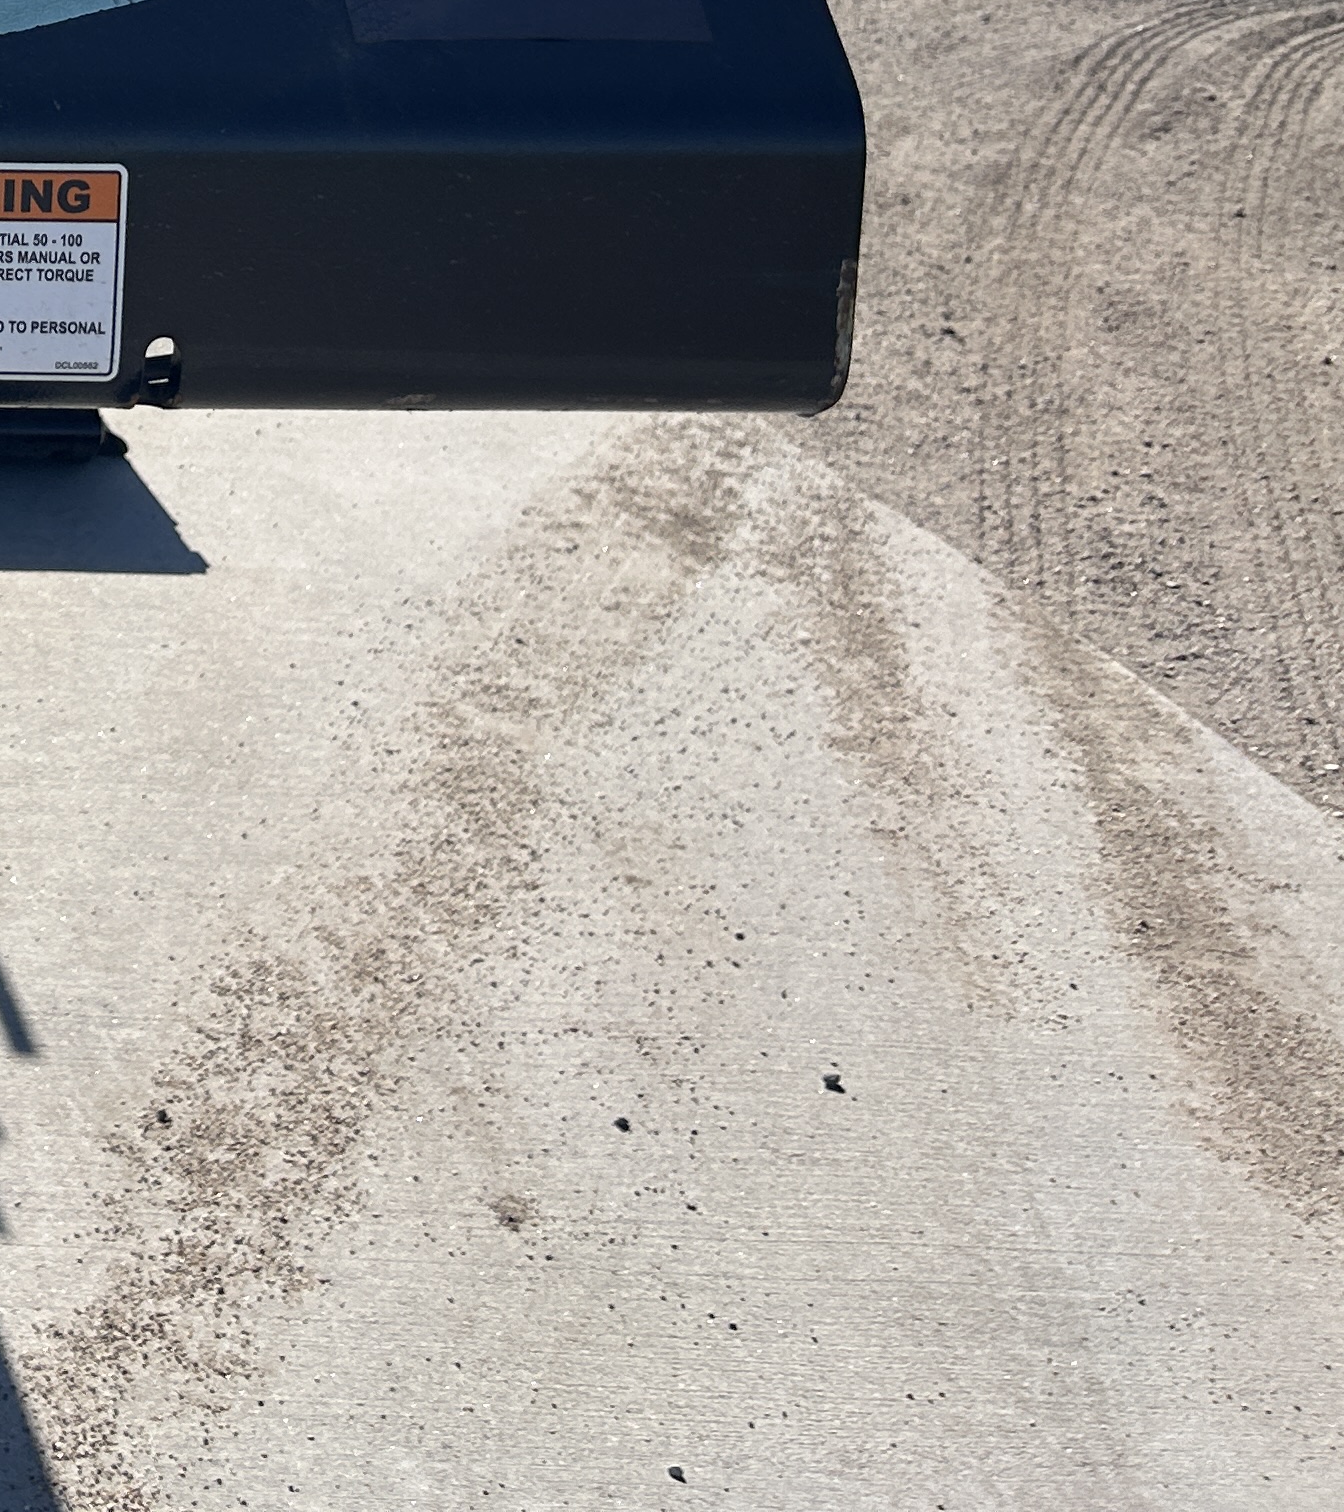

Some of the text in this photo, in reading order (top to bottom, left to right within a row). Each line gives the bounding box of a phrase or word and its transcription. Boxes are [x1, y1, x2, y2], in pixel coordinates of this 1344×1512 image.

[33, 234, 47, 246] 50
[61, 234, 82, 247] 100
[18, 251, 76, 264] MANUAL
[80, 252, 100, 264] OR
[37, 269, 94, 282] TORQUE
[9, 321, 26, 333] TO
[31, 321, 105, 334] PERSONAL
